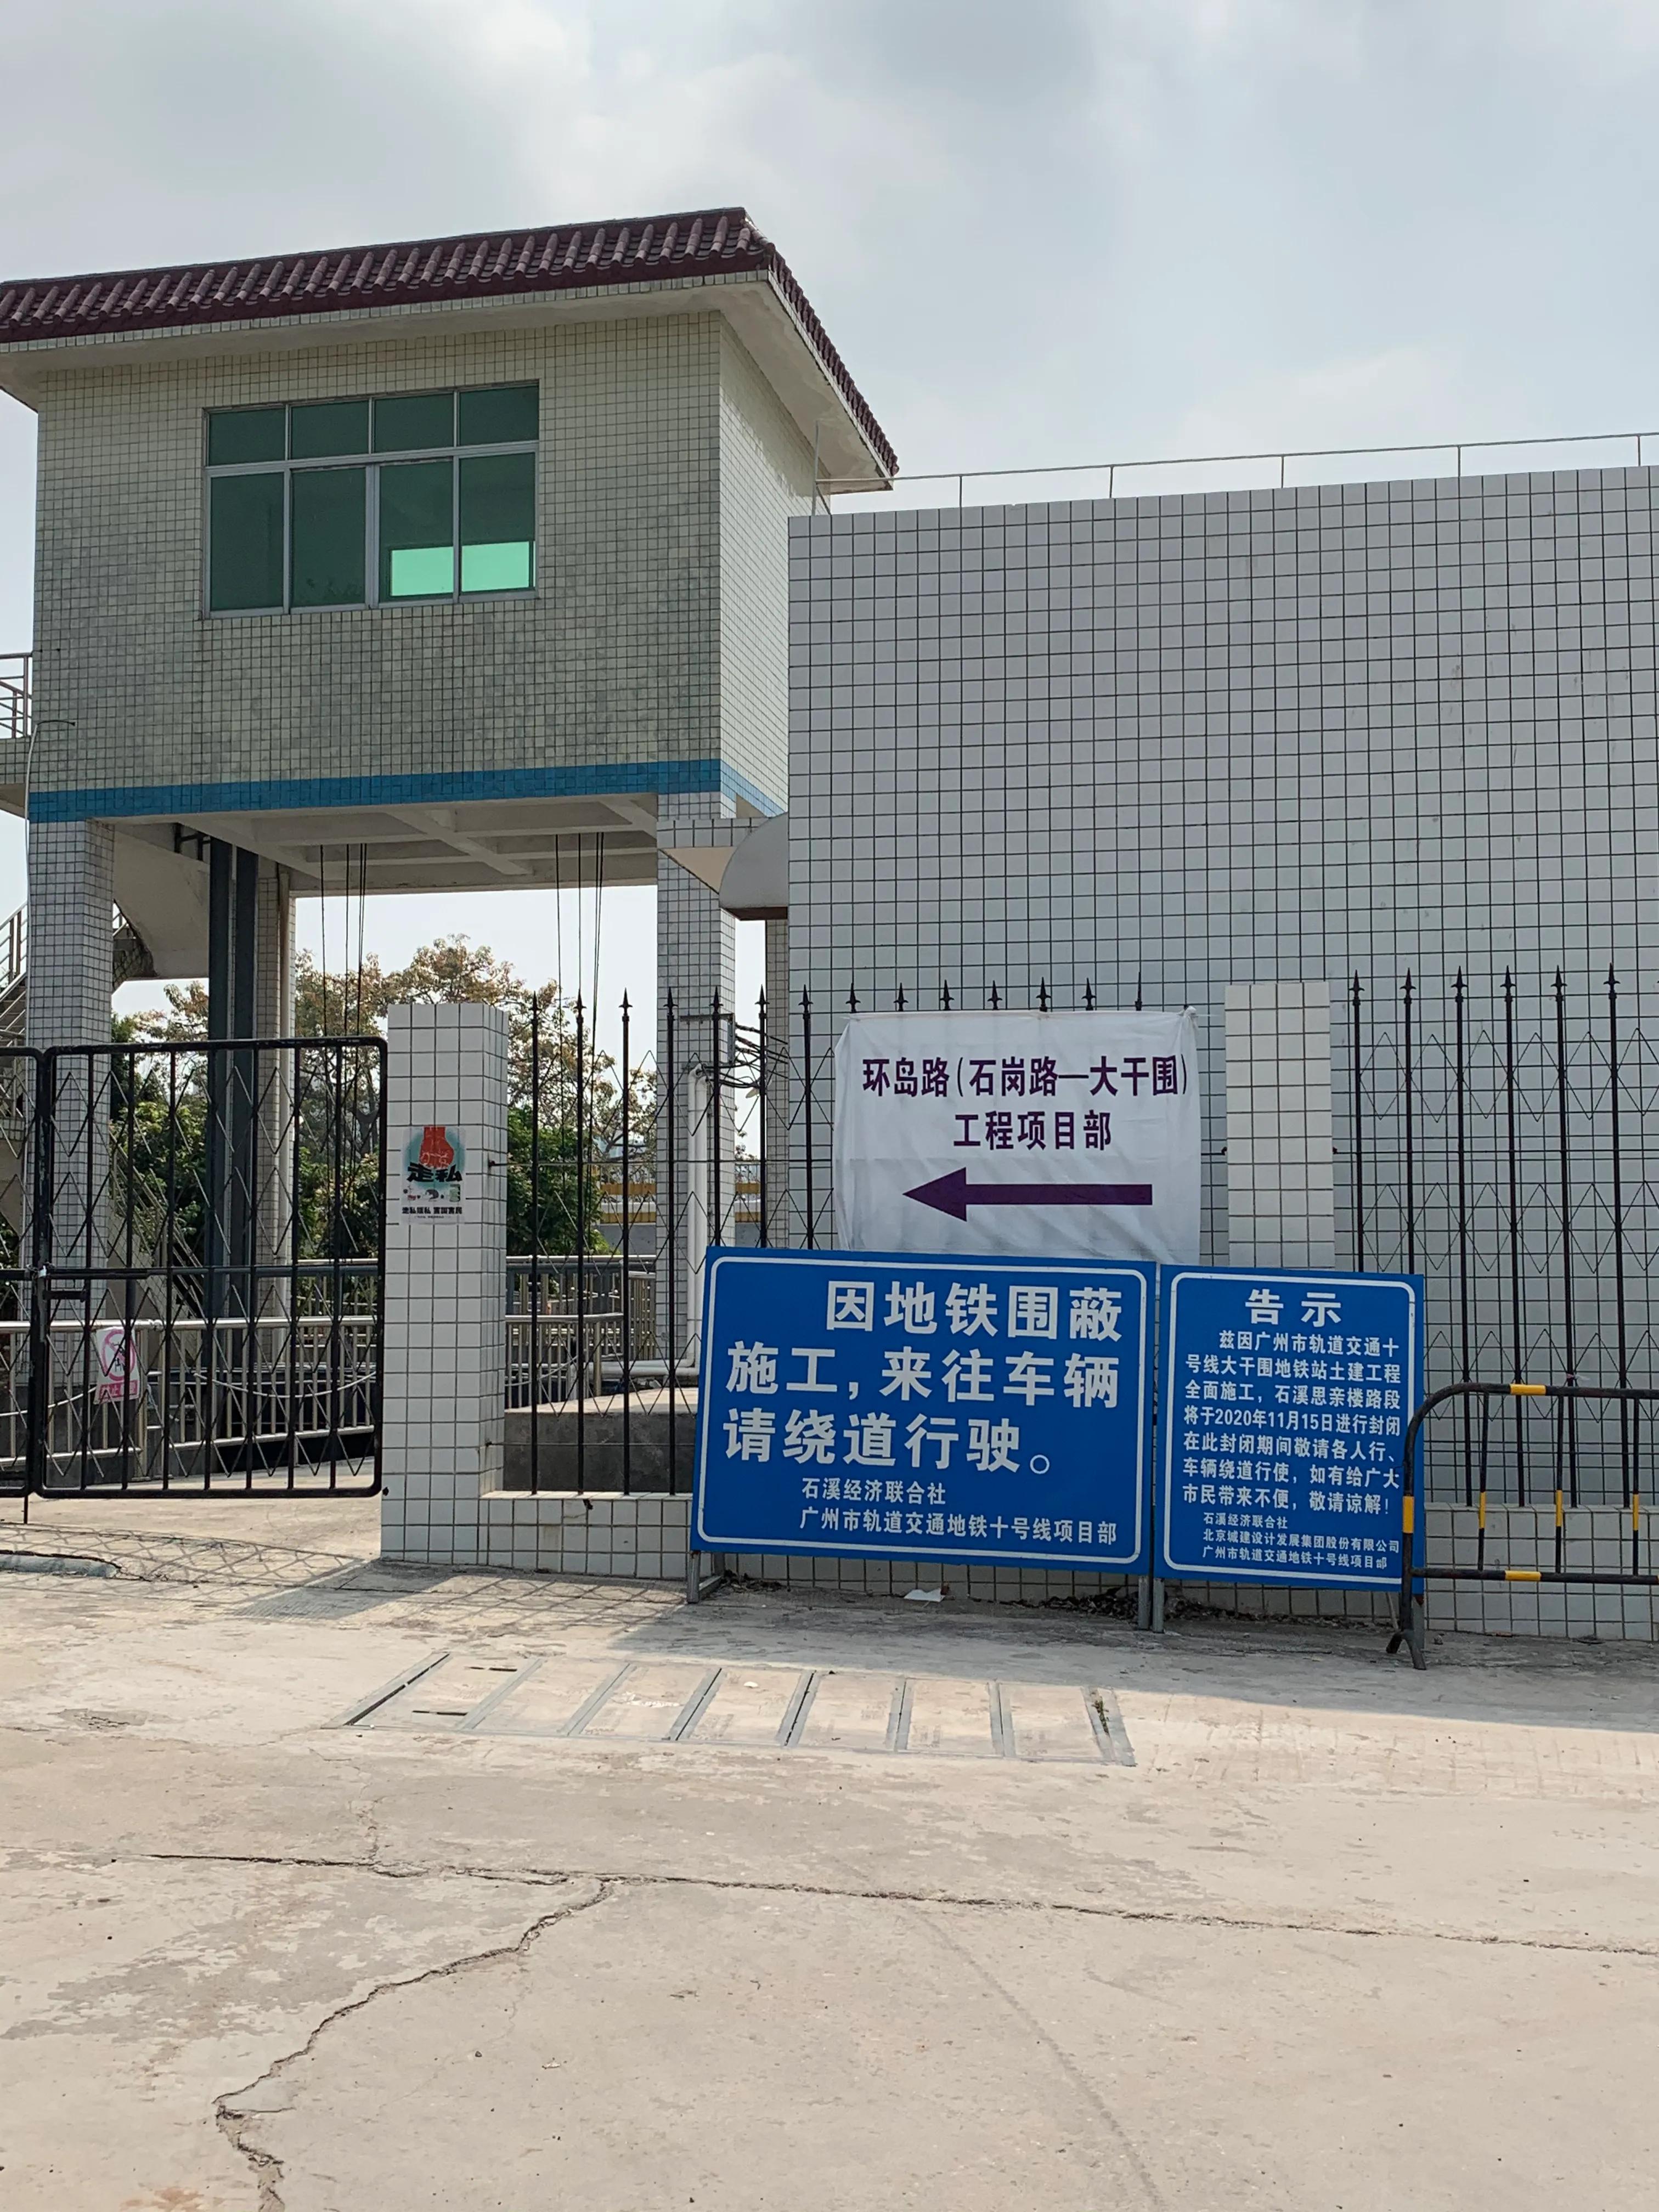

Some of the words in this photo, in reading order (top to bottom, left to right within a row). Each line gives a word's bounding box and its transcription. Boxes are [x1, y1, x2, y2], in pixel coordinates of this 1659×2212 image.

[953, 1109, 1111, 1151] 工程项目部
[826, 1280, 1122, 1342] 因地铁围蔽
[1245, 1288, 1342, 1328] 告示
[1219, 1330, 1400, 1357] 兹因广州市轨道交通十
[725, 1340, 1120, 1409] 施工，来往车辆
[1186, 1354, 1401, 1384] 号线大干围地铁站土建工程
[1184, 1379, 1401, 1410] 全面施工，石溪思亲楼路段
[1183, 1405, 1401, 1437] 将于2020年11月15日进行封闭
[723, 1407, 1051, 1474] 请绕道行驶。
[1183, 1431, 1395, 1463] 在此封闭期间敬请各人行、
[1183, 1457, 1400, 1489] 车辆绕道行使，如有给广大
[802, 1477, 946, 1505] 石溪经济联合社
[799, 1506, 1117, 1545] 广州市轨道交通地铁十号线项目部
[1203, 1513, 1288, 1529] 石溪经济联合社
[1203, 1529, 1400, 1554] 北京城建设计发展集团股份有限公司
[1203, 1546, 1387, 1570] 广州市轨道交通地铁十号线项目部
